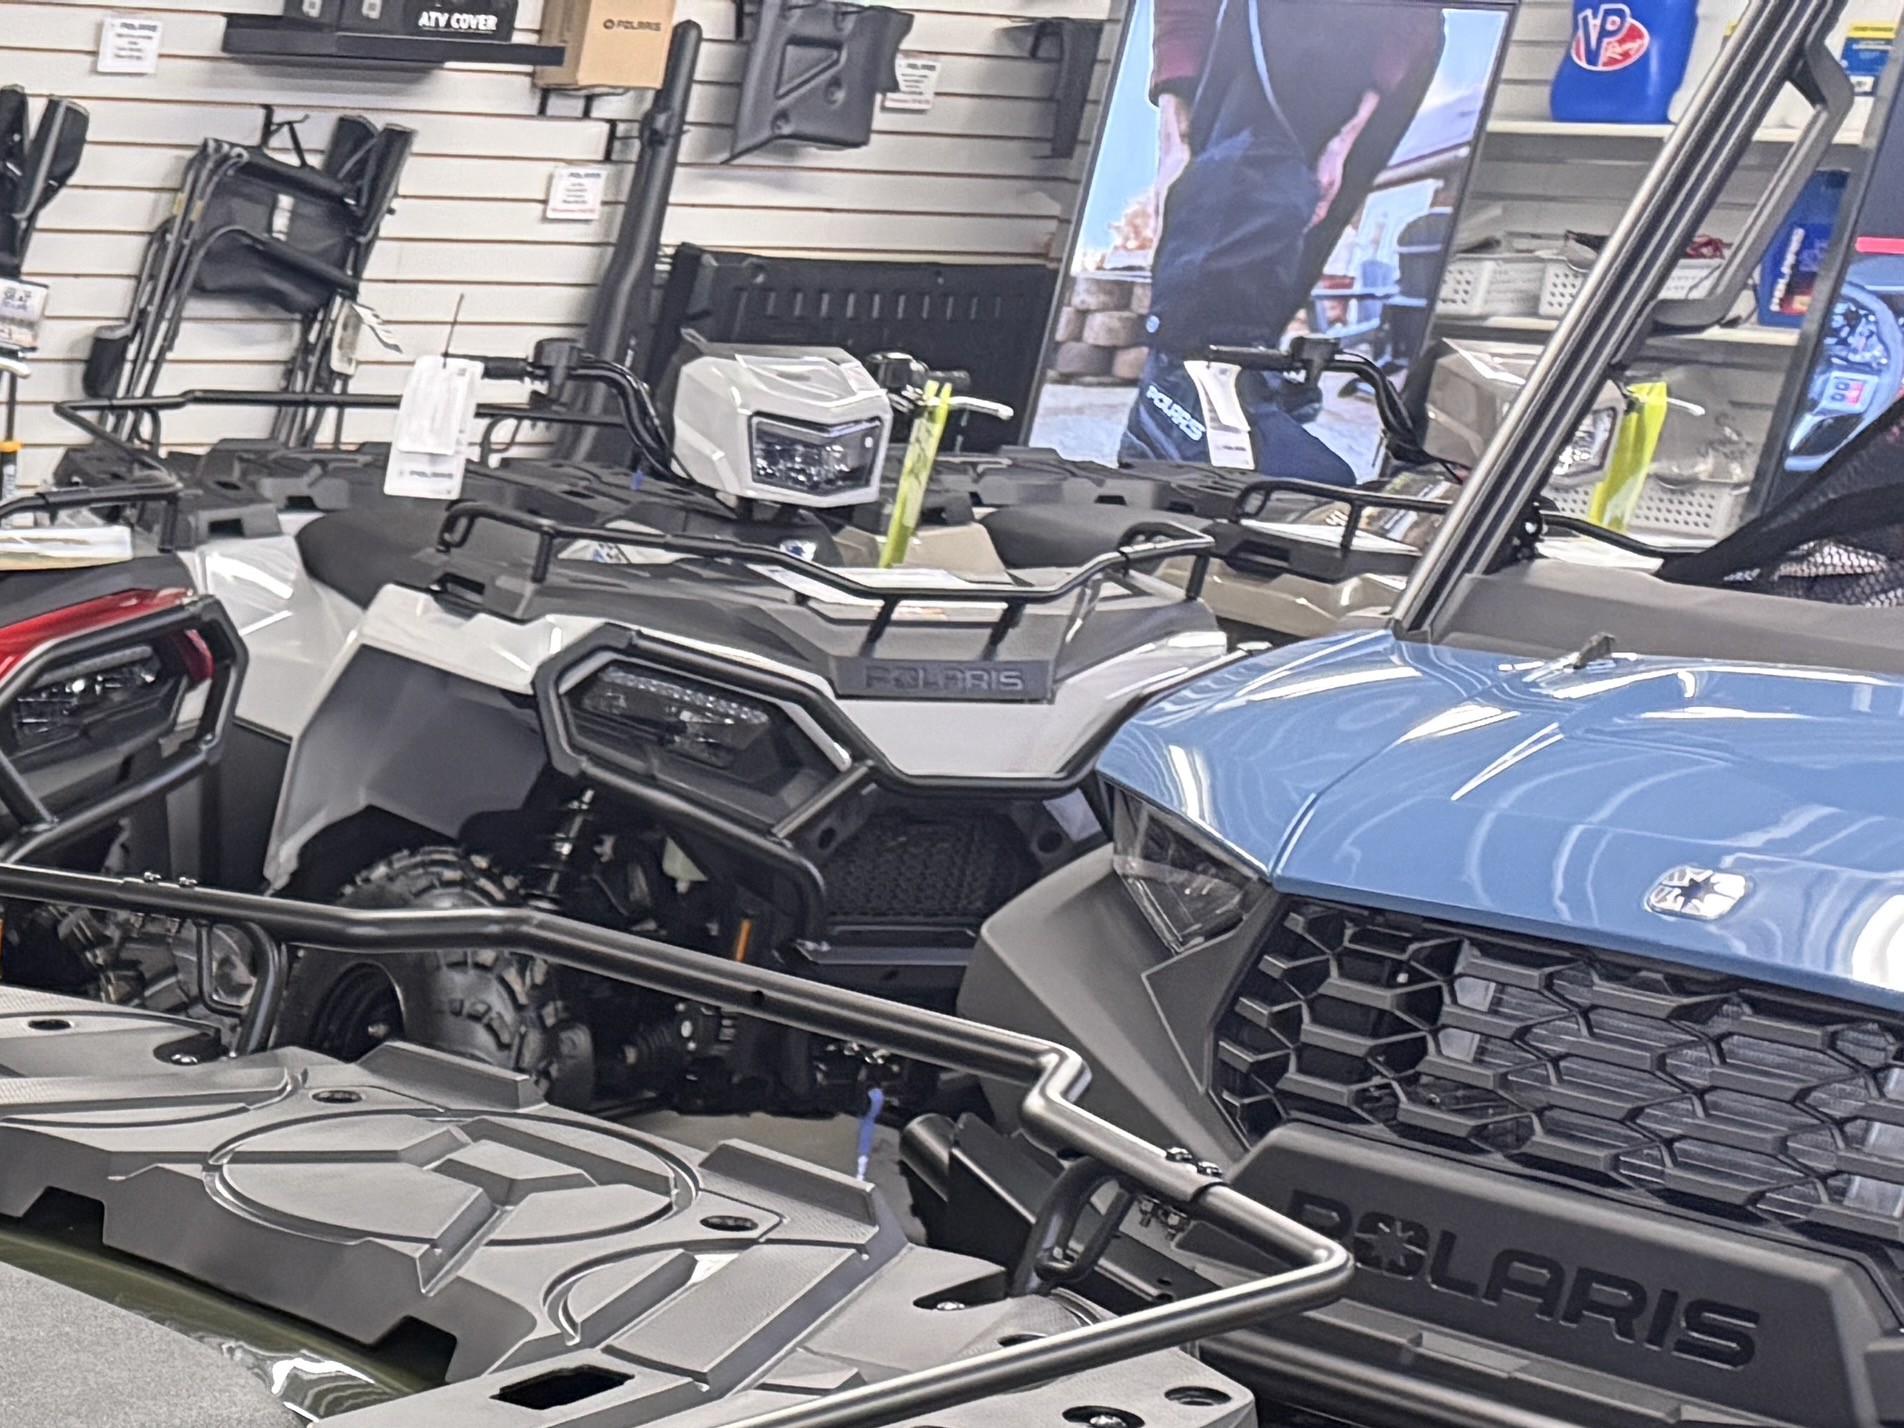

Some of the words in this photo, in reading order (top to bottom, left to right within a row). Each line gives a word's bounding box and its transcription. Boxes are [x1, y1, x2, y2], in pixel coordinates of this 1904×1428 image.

[418, 11, 448, 29] ATV
[450, 12, 498, 31] COVER
[865, 664, 1024, 691] POLARIS
[1293, 1193, 1761, 1372] POLARIS
